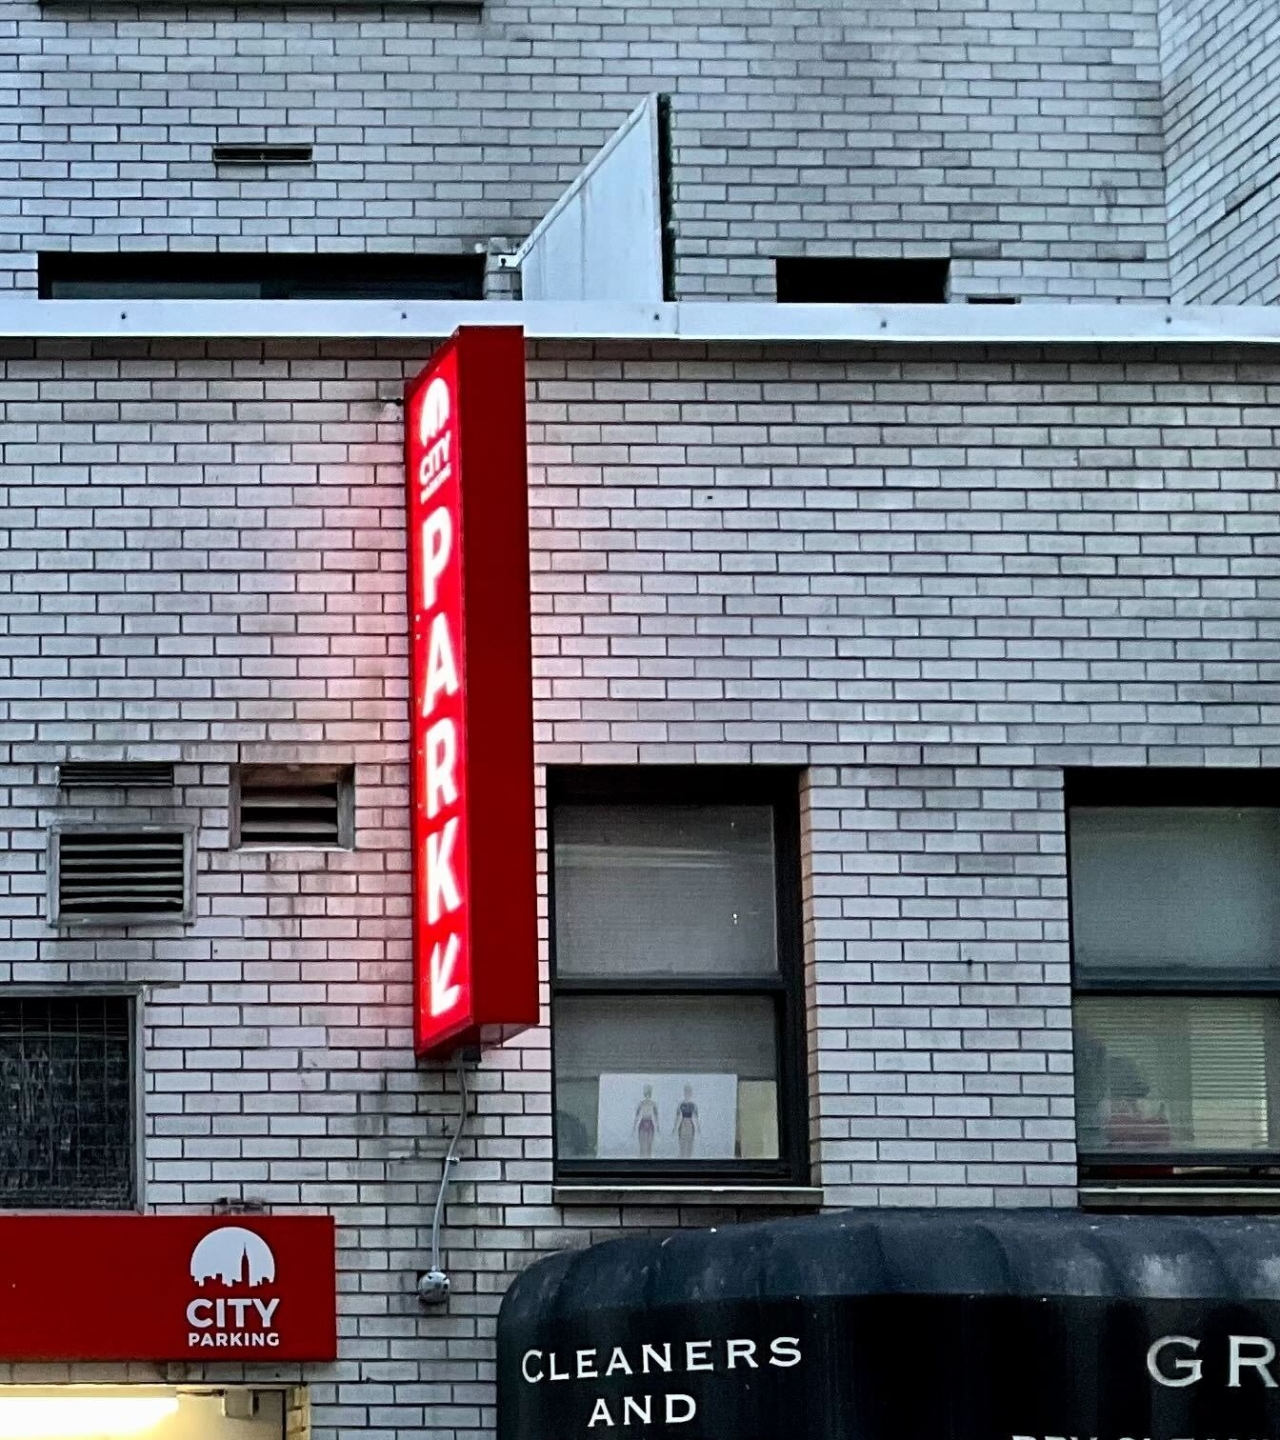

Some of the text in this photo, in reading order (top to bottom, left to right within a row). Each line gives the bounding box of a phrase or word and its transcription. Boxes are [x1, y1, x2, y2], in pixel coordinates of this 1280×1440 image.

[421, 505, 461, 926] PARK
[186, 1298, 280, 1328] CITY
[188, 1332, 280, 1347] PARKING
[521, 1336, 803, 1384] CLEANERS
[587, 1393, 697, 1427] AND
